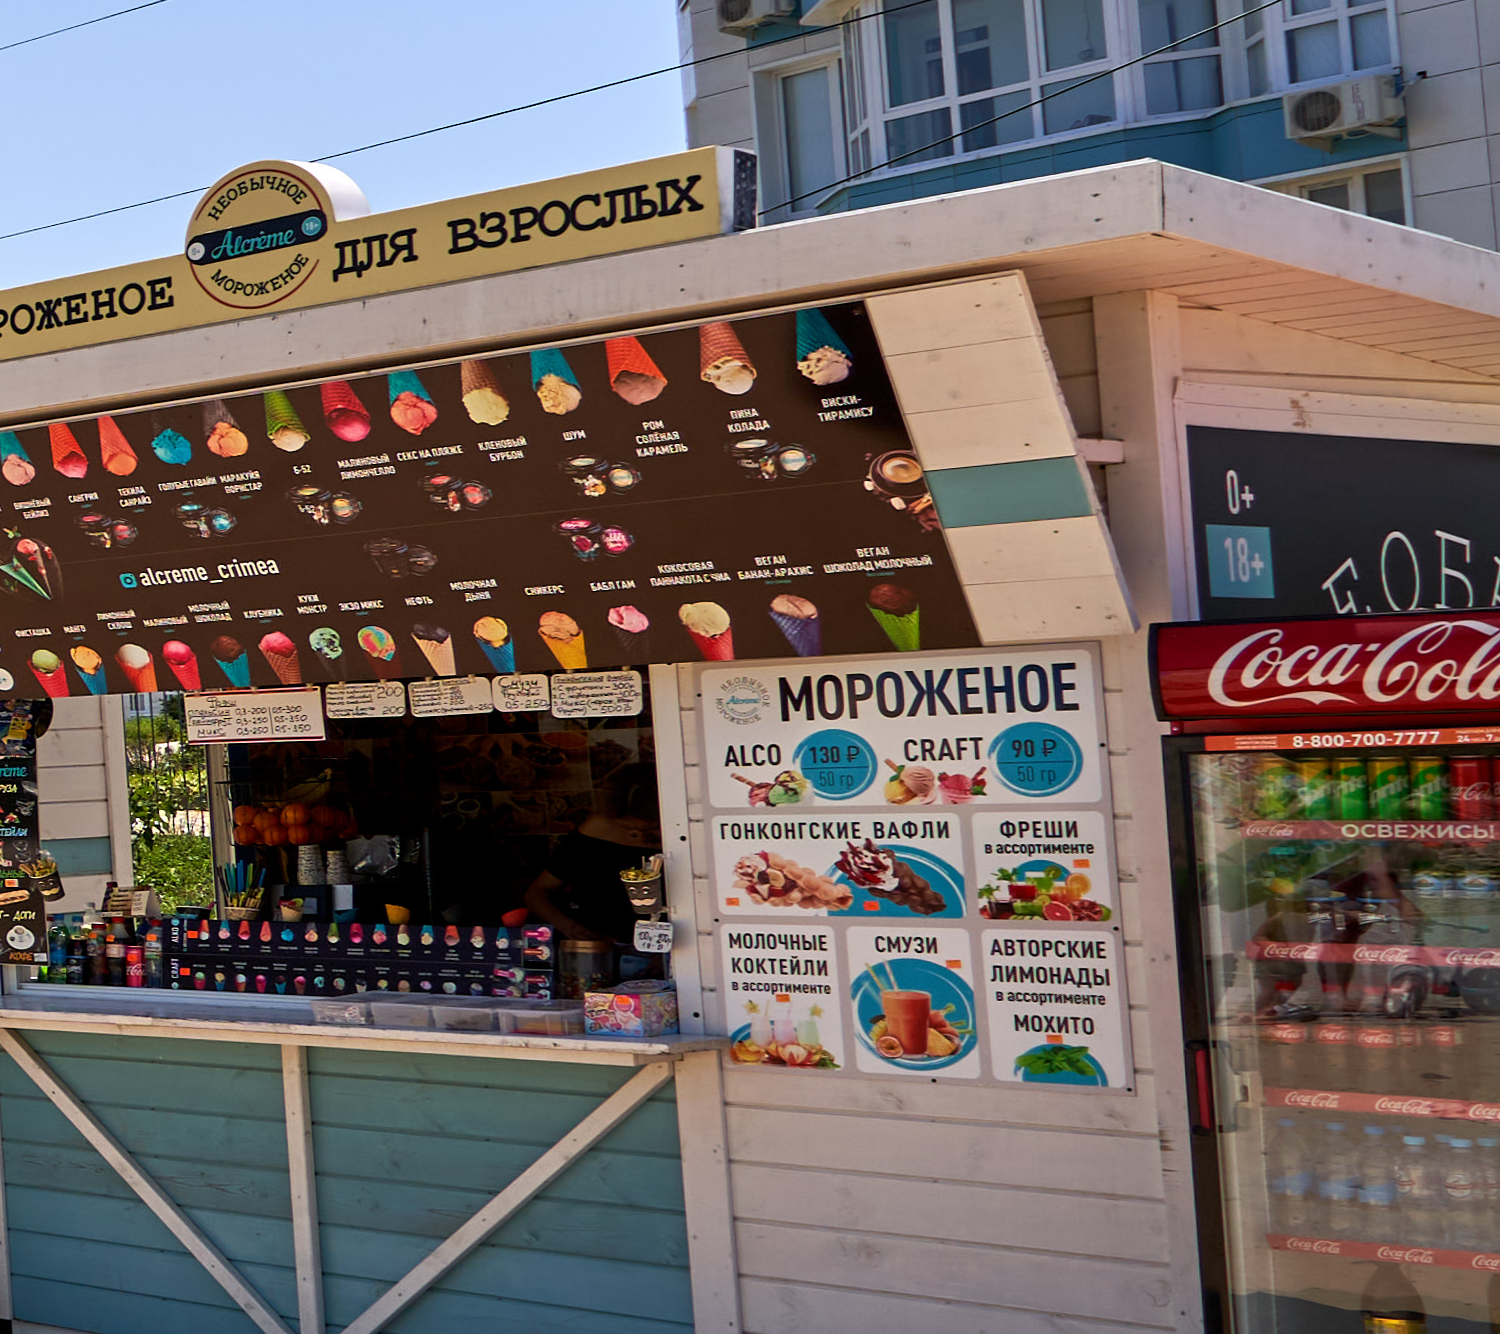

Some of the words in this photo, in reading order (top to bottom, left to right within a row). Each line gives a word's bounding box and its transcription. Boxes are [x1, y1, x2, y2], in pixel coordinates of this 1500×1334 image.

[208, 175, 307, 221] НЕОБЫЧНОЕ
[332, 226, 418, 282] ДЛЯ
[447, 174, 704, 255] ВЗРОСЛЫХ
[211, 228, 296, 260] Alcrème
[211, 253, 309, 296] МОРОЖЕНОЕ
[818, 407, 874, 423] ТИРАМИСУ
[643, 420, 664, 431] РОМ
[727, 419, 770, 434] КОЛАДА
[432, 444, 464, 458] ПЛЯЖЕ
[636, 443, 688, 458] КАРАМЕЛЬ
[1225, 469, 1255, 515] 0+
[754, 554, 787, 566] ВЕГАН
[855, 546, 890, 558] ВЕГАН
[1223, 536, 1264, 583] 18+
[139, 557, 280, 587] alcreme_crimea
[823, 560, 875, 574] ШОКОЛАД
[778, 662, 1080, 722] МОРОЖЕНОЕ
[1011, 739, 1035, 758] 90
[1292, 731, 1441, 749] 8-800-700-7777
[725, 743, 782, 767] ALCO
[808, 746, 841, 764] 130
[903, 737, 983, 762] CRAFT
[818, 772, 838, 787] 50
[840, 775, 854, 791] гр
[1017, 767, 1036, 783] 50
[1038, 770, 1057, 786] гр
[720, 821, 862, 840] ГОНКОНГСКИЕ
[872, 820, 950, 840] ВАФЛИ
[1000, 820, 1079, 840] ФРЕШИ
[1246, 824, 1295, 837] Coca-Cola
[1341, 823, 1495, 839] ОСВЕЖИСЬ!
[984, 843, 993, 855] в
[996, 842, 1095, 856] ассортименте
[728, 932, 828, 951] МОЛОЧНЫЕ
[875, 935, 938, 955] СМУЗИ
[991, 939, 1107, 960] АВТОРСКИЕ
[1263, 943, 1319, 960] Coca-Cola
[1353, 946, 1410, 963] Coca-Cola
[731, 956, 829, 977] КОКТЕЙЛИ
[991, 965, 1110, 988] ЛИМОНАДЫ
[731, 981, 739, 991] в
[741, 982, 832, 996] ассортименте
[996, 991, 1004, 1002] в
[1005, 990, 1106, 1006] ассортименте
[1014, 1014, 1094, 1035] МОХИТО
[1285, 1092, 1341, 1109] Coca-Cola
[1374, 1097, 1433, 1115] Coca-Cola
[1286, 1238, 1342, 1254] Coca-Cola
[1377, 1246, 1435, 1264] Coca-Cola
